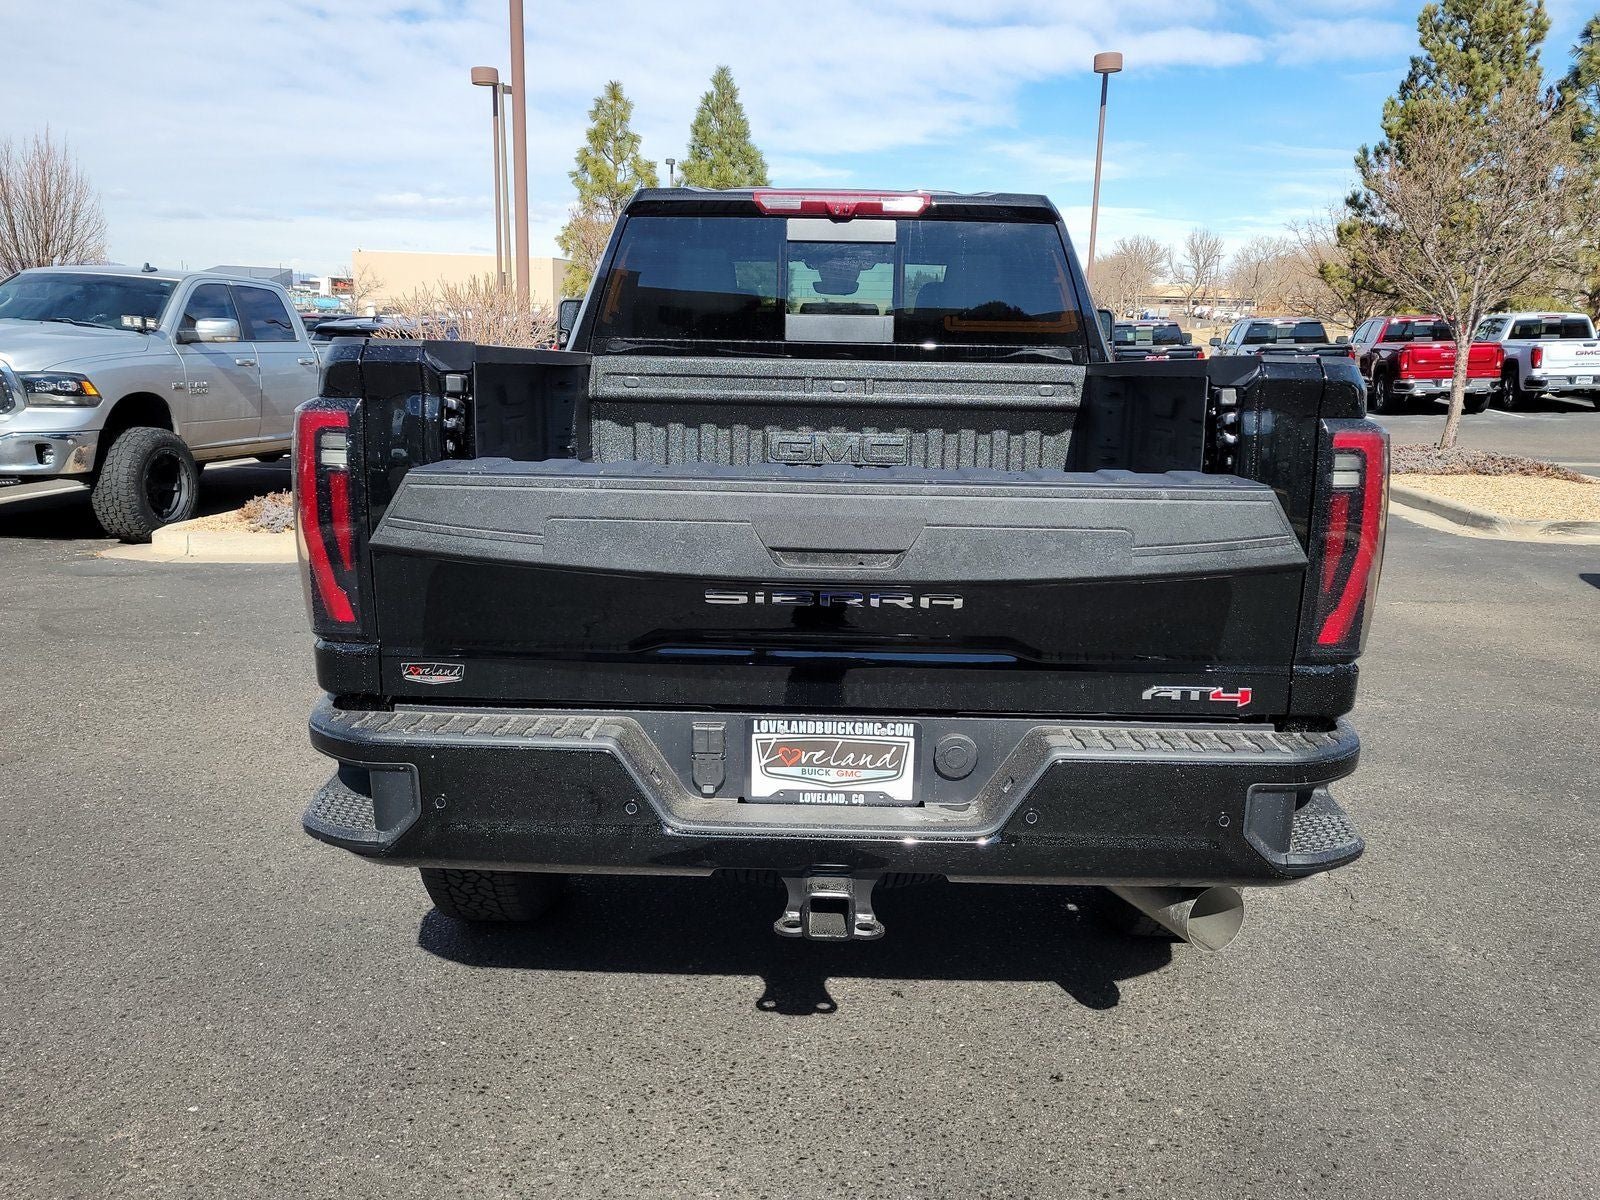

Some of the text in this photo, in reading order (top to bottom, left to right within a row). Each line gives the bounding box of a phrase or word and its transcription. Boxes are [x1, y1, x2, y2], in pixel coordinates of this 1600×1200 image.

[769, 433, 908, 464] GMC
[704, 589, 964, 610] SIERRA
[1141, 685, 1252, 707] AT4
[753, 719, 914, 737] LOVELANDBUICKGMCCOM
[801, 768, 862, 778] BUICK GMC
[852, 793, 865, 804] CO
